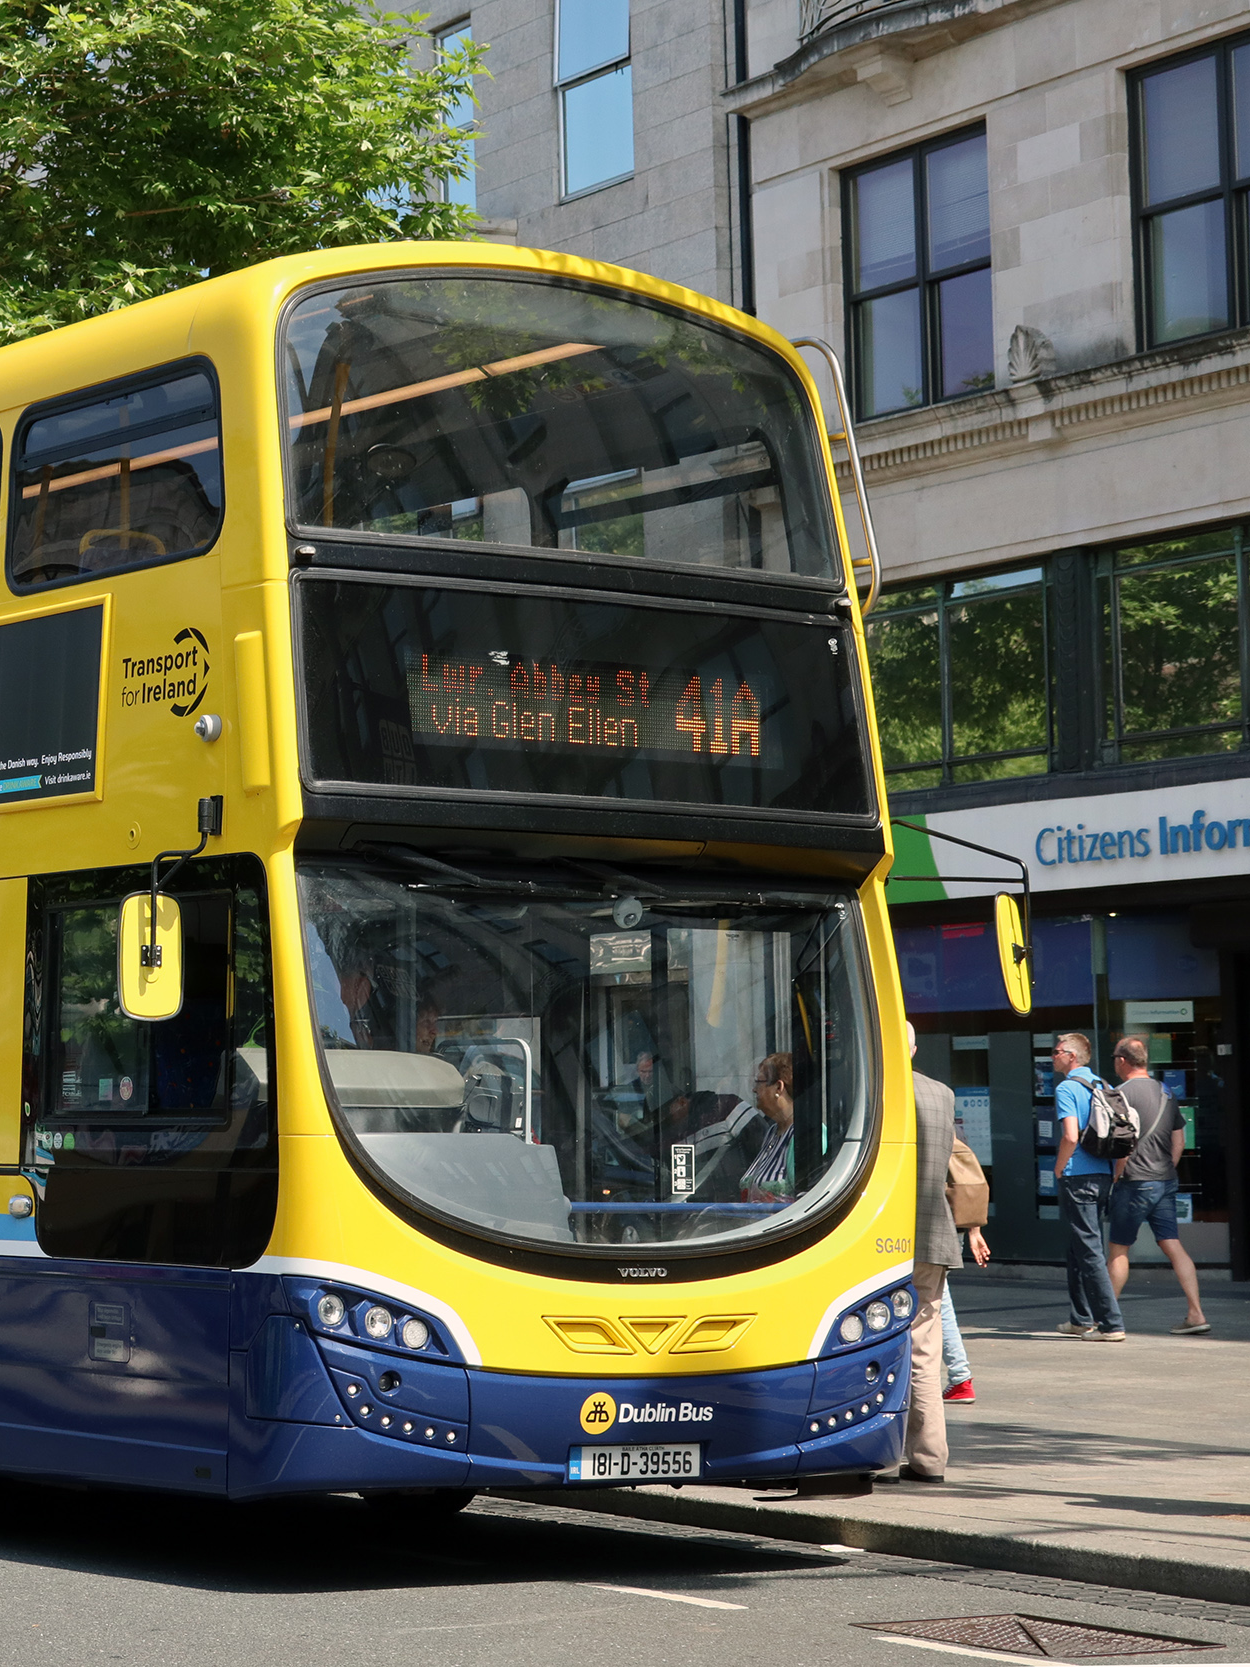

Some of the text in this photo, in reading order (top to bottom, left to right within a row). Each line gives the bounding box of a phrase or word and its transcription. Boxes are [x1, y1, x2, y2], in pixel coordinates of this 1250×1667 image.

[122, 646, 198, 678] Transport
[121, 673, 197, 707] for Ireland
[422, 654, 650, 708] Lwr. Abbey St
[492, 701, 554, 741] Glen
[568, 707, 638, 747] Ellen
[675, 676, 760, 756] 41A
[7, 758, 25, 769] Danish
[26, 758, 39, 768] way.
[41, 753, 57, 765] Enjoy
[58, 748, 92, 762] Responsibly
[2, 778, 37, 790] DRINKAWARE
[44, 770, 91, 785] Visit drinkaware.ie
[1036, 810, 1250, 866] Citizens Infor
[875, 1238, 912, 1254] SG401
[617, 1267, 668, 1278] VOLVO
[618, 1402, 713, 1423] Dublin Bus
[570, 1466, 580, 1474] IRL
[592, 1451, 692, 1476] 181-D-39556
